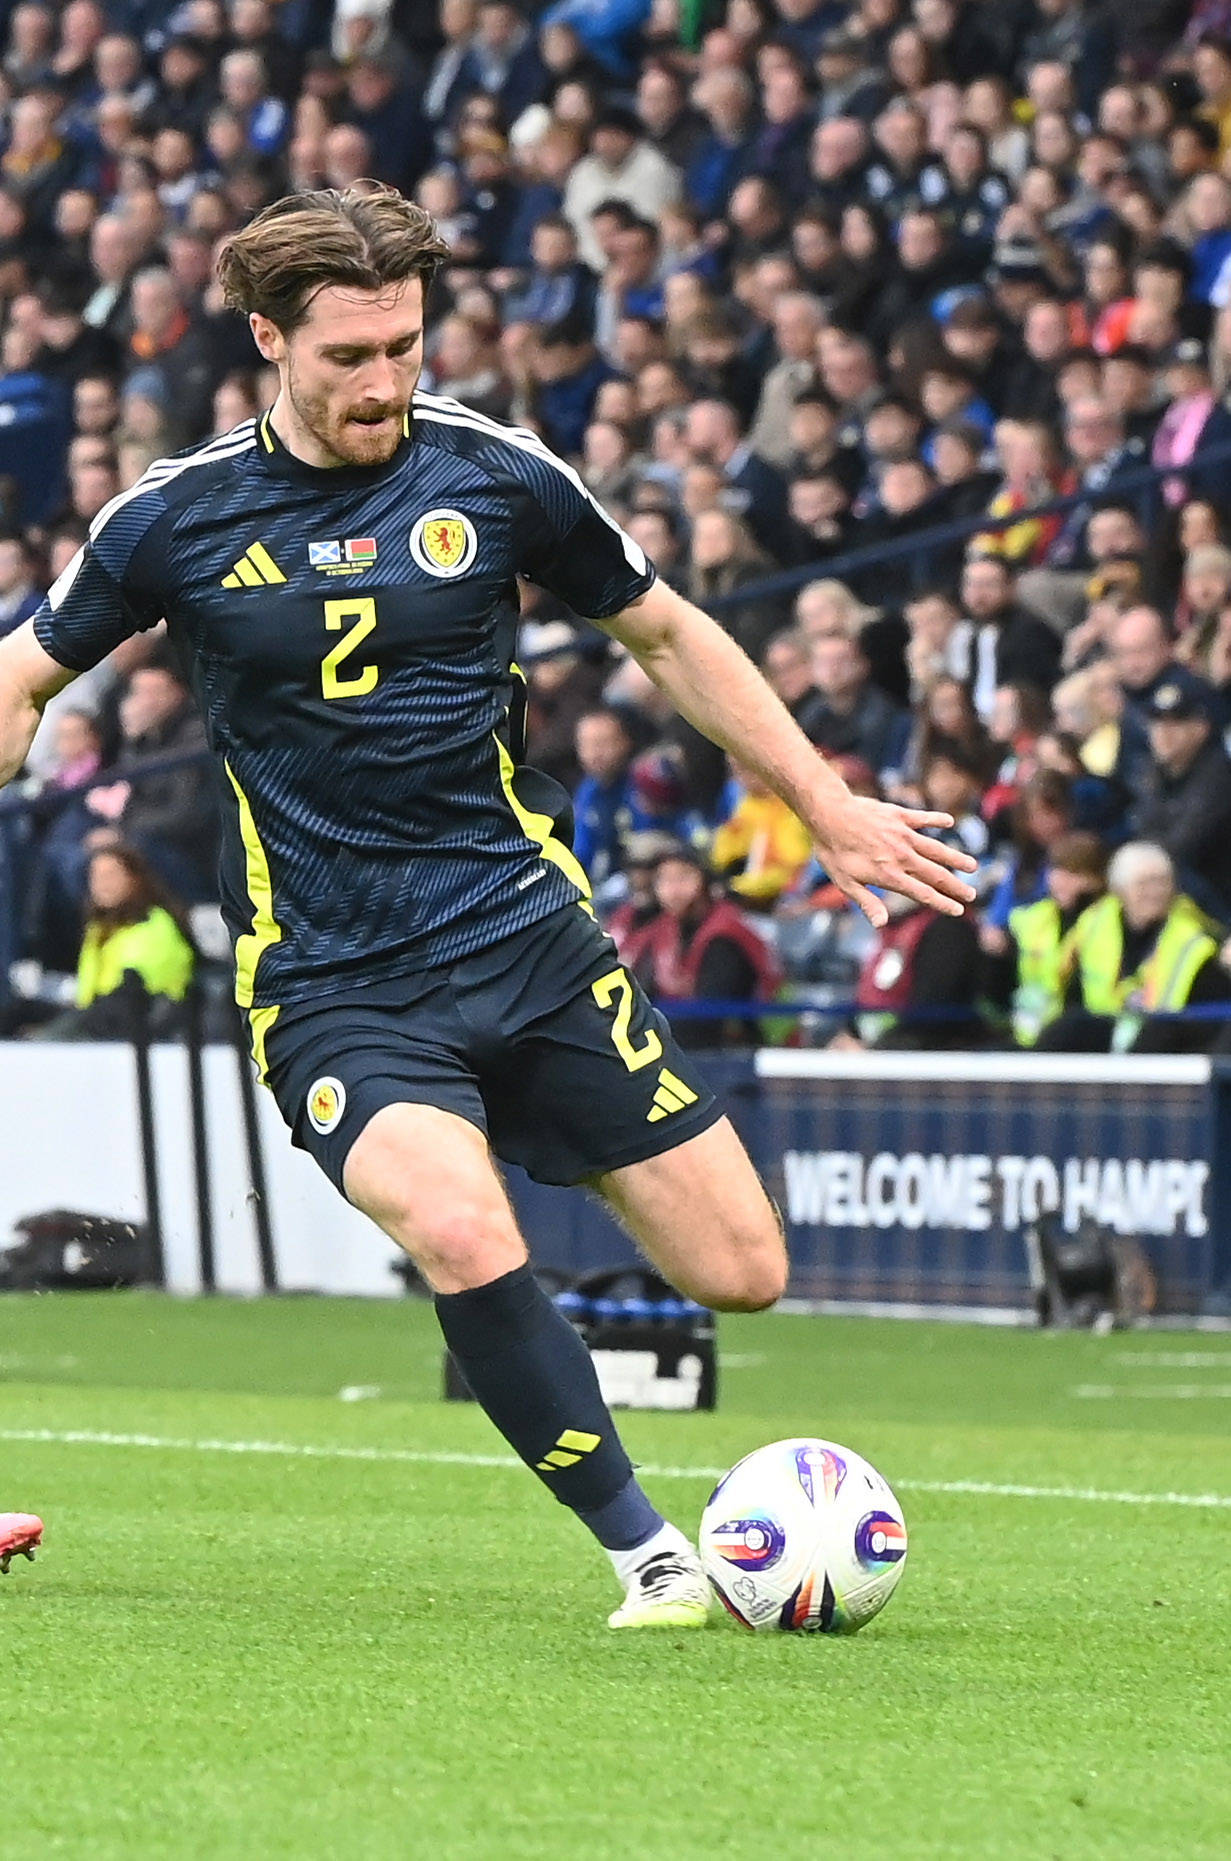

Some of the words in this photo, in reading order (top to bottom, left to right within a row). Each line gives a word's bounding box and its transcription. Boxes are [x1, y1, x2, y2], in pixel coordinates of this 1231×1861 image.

[321, 597, 379, 700] 2
[591, 967, 663, 1073] 2
[781, 1149, 992, 1232] WELCOME
[995, 1154, 1060, 1232] TO
